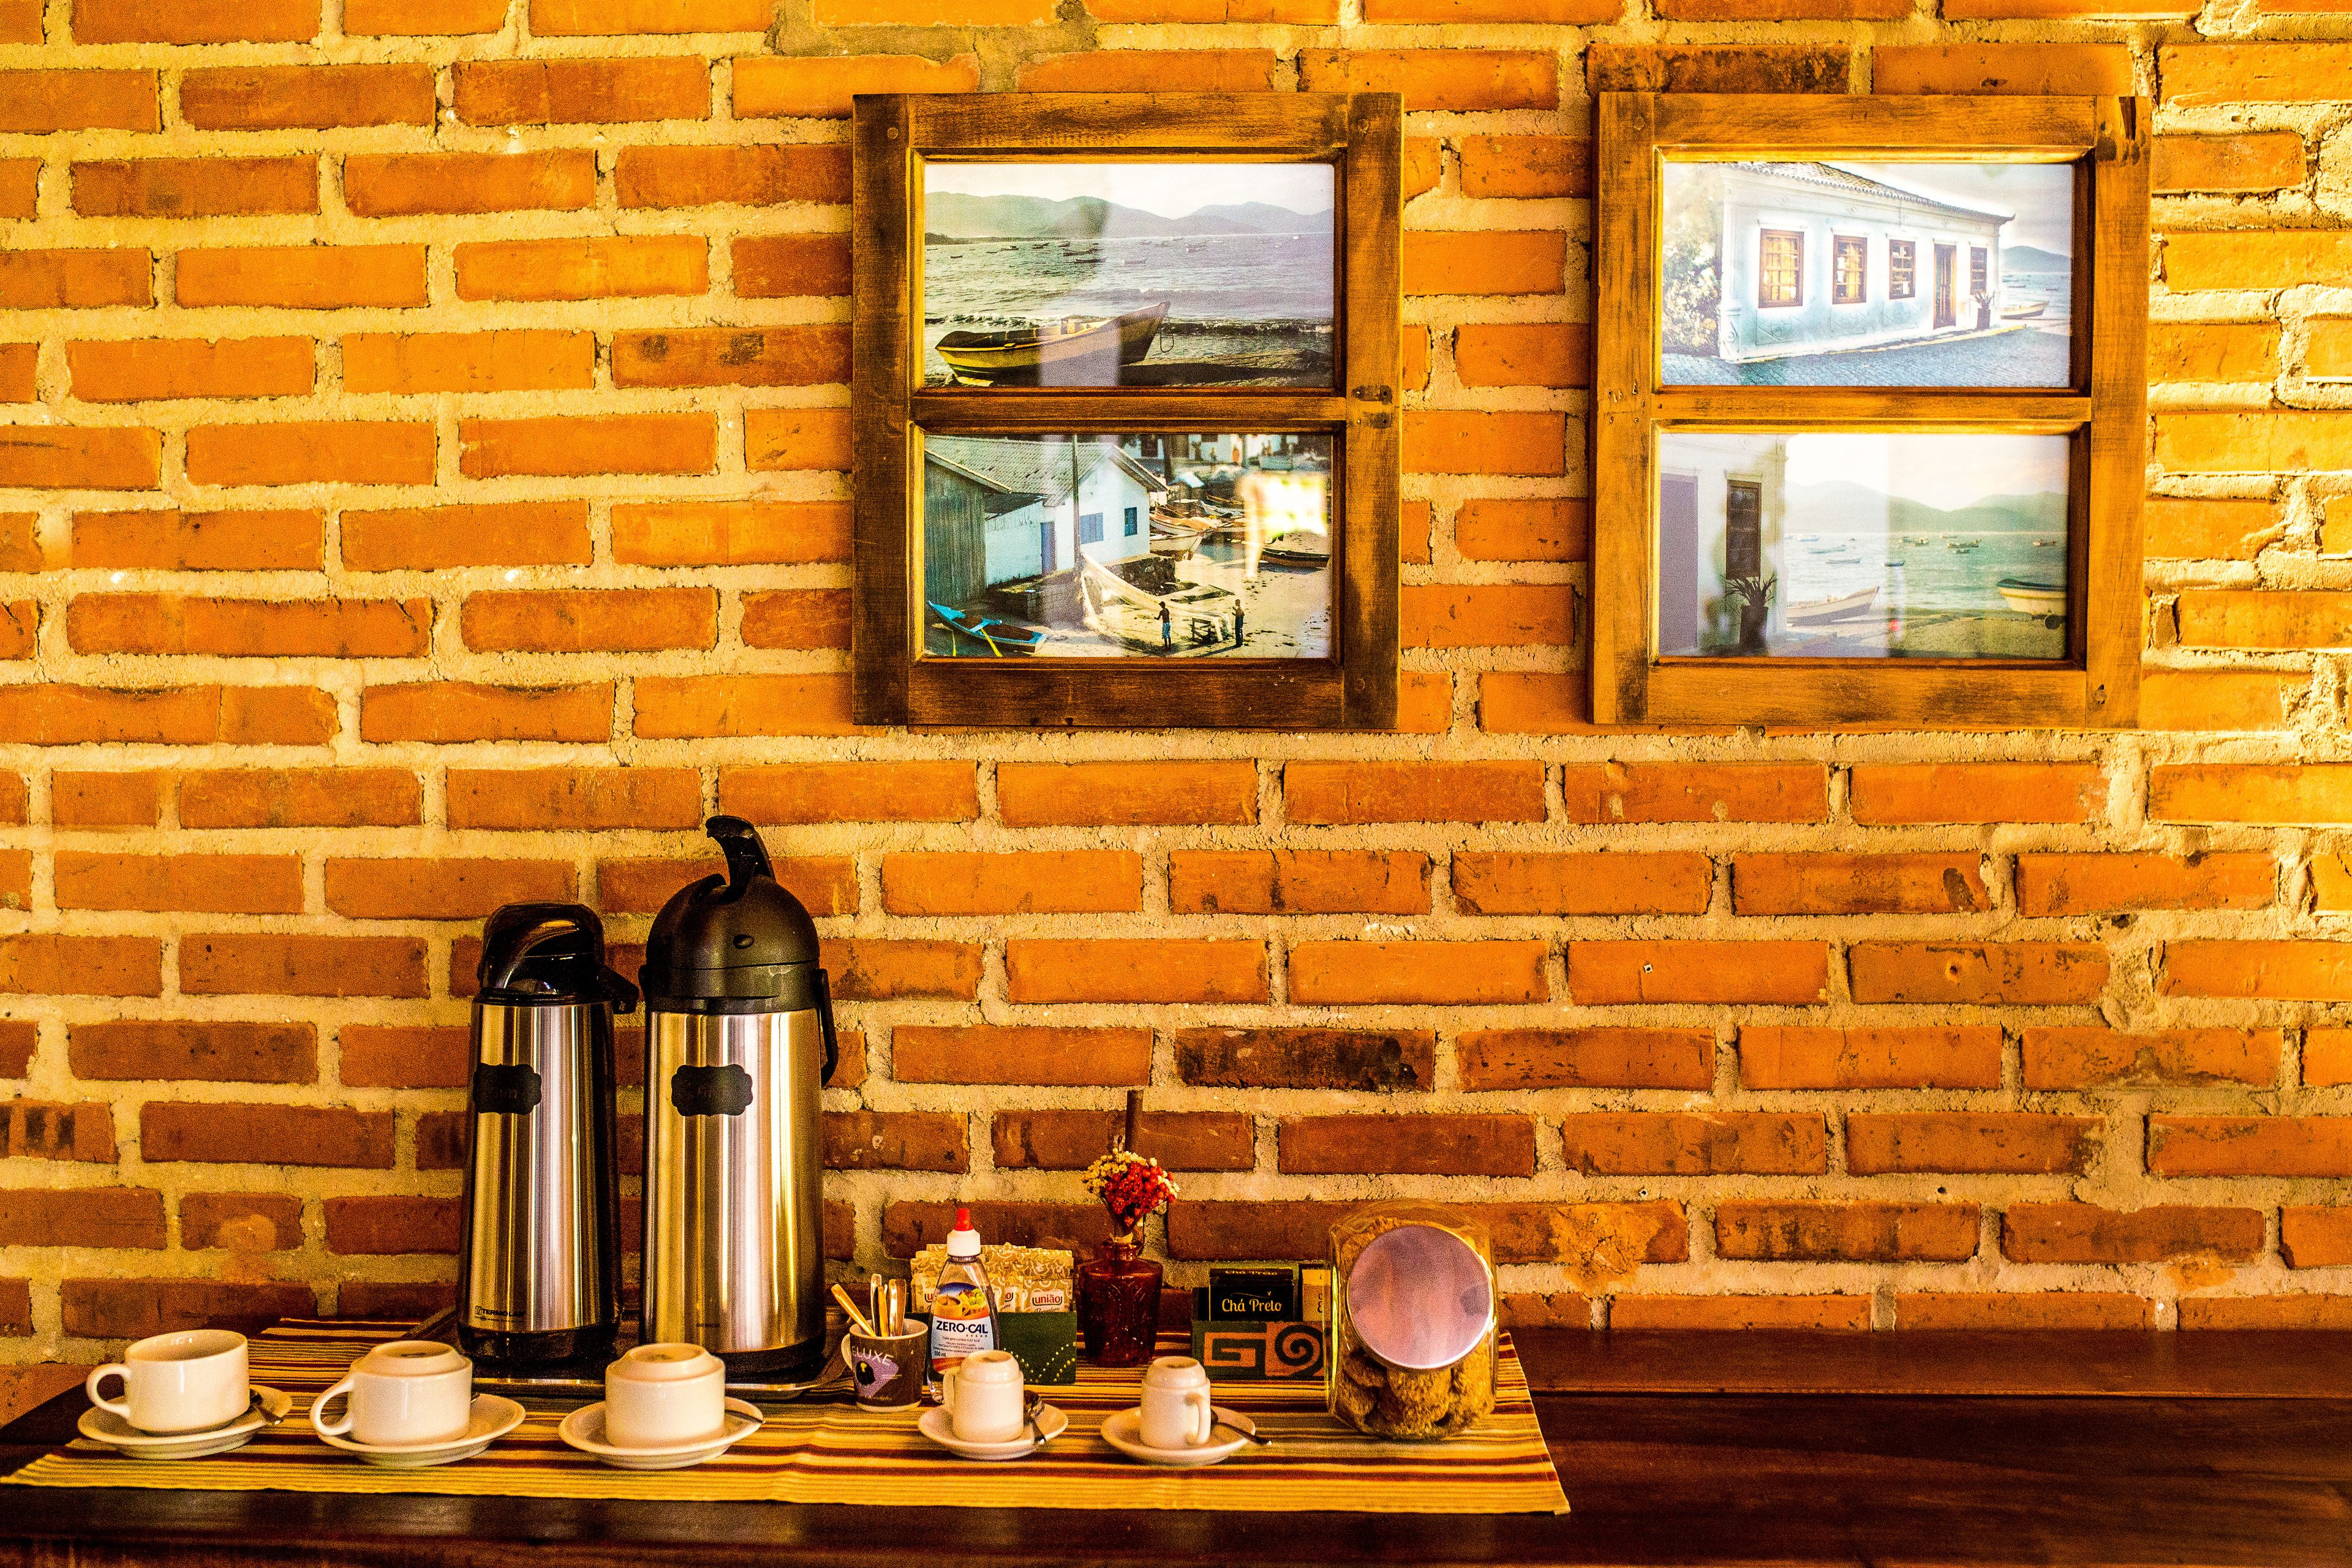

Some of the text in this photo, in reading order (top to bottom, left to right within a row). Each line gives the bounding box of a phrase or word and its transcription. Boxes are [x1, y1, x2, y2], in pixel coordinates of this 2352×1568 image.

[1035, 1295, 1061, 1303] união
[1222, 1298, 1282, 1311] Chá Preto
